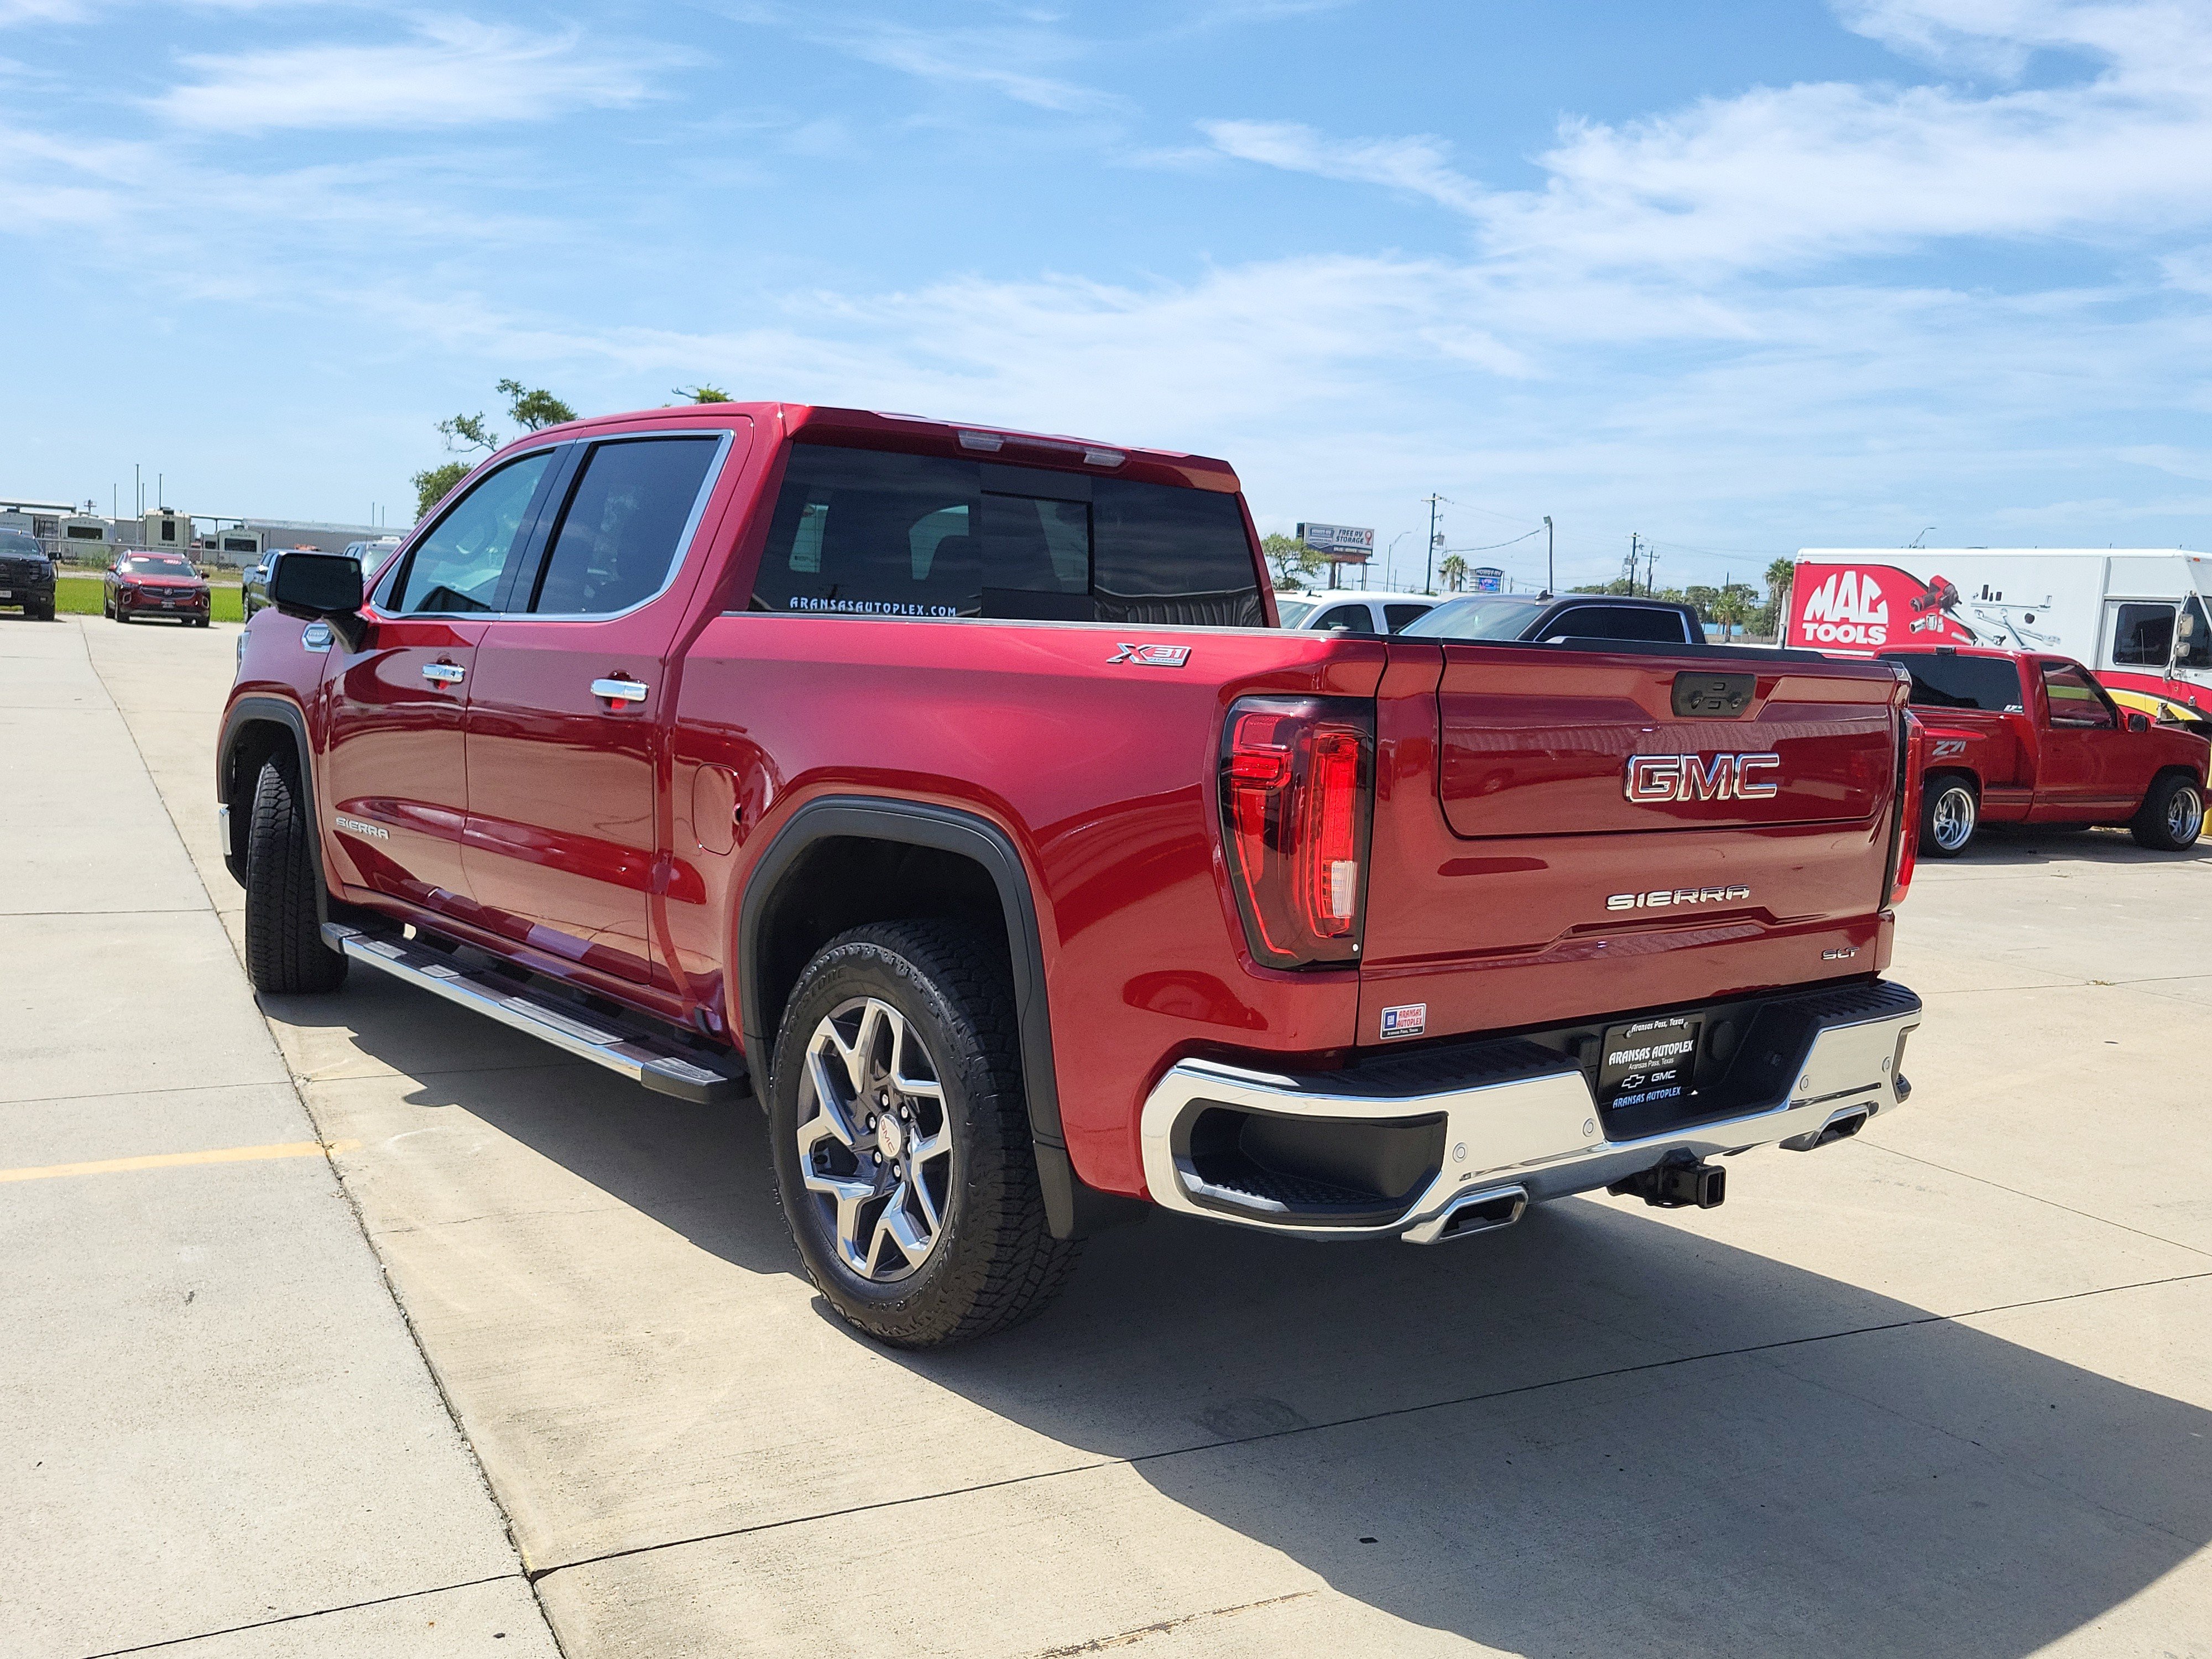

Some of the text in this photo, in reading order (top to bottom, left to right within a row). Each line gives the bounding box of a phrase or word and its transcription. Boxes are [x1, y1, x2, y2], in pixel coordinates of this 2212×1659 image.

[790, 596, 957, 617] ARANSASAUTOPLEX.COM
[1803, 571, 1888, 624] MAC
[1802, 623, 1887, 645] TOOLS
[1932, 741, 1966, 755] Z71
[1623, 753, 1780, 802] GMC
[336, 817, 389, 840] SIERRA
[1606, 884, 1750, 910] SIERRA
[1821, 947, 1860, 960] SLT
[1397, 1018, 1422, 1028] AUTOPLEX
[1399, 1008, 1422, 1018] ARANSAS
[1631, 1024, 1653, 1032] Aransas
[1670, 1018, 1684, 1026] Texas
[1609, 1040, 1694, 1066] ARANSAS AUTOPLEX
[1628, 1062, 1647, 1070] Aransas
[1651, 1070, 1677, 1082] GMC
[1613, 1086, 1682, 1109] ARANSAS AUTOPLEX
[881, 1119, 895, 1153] GMC
